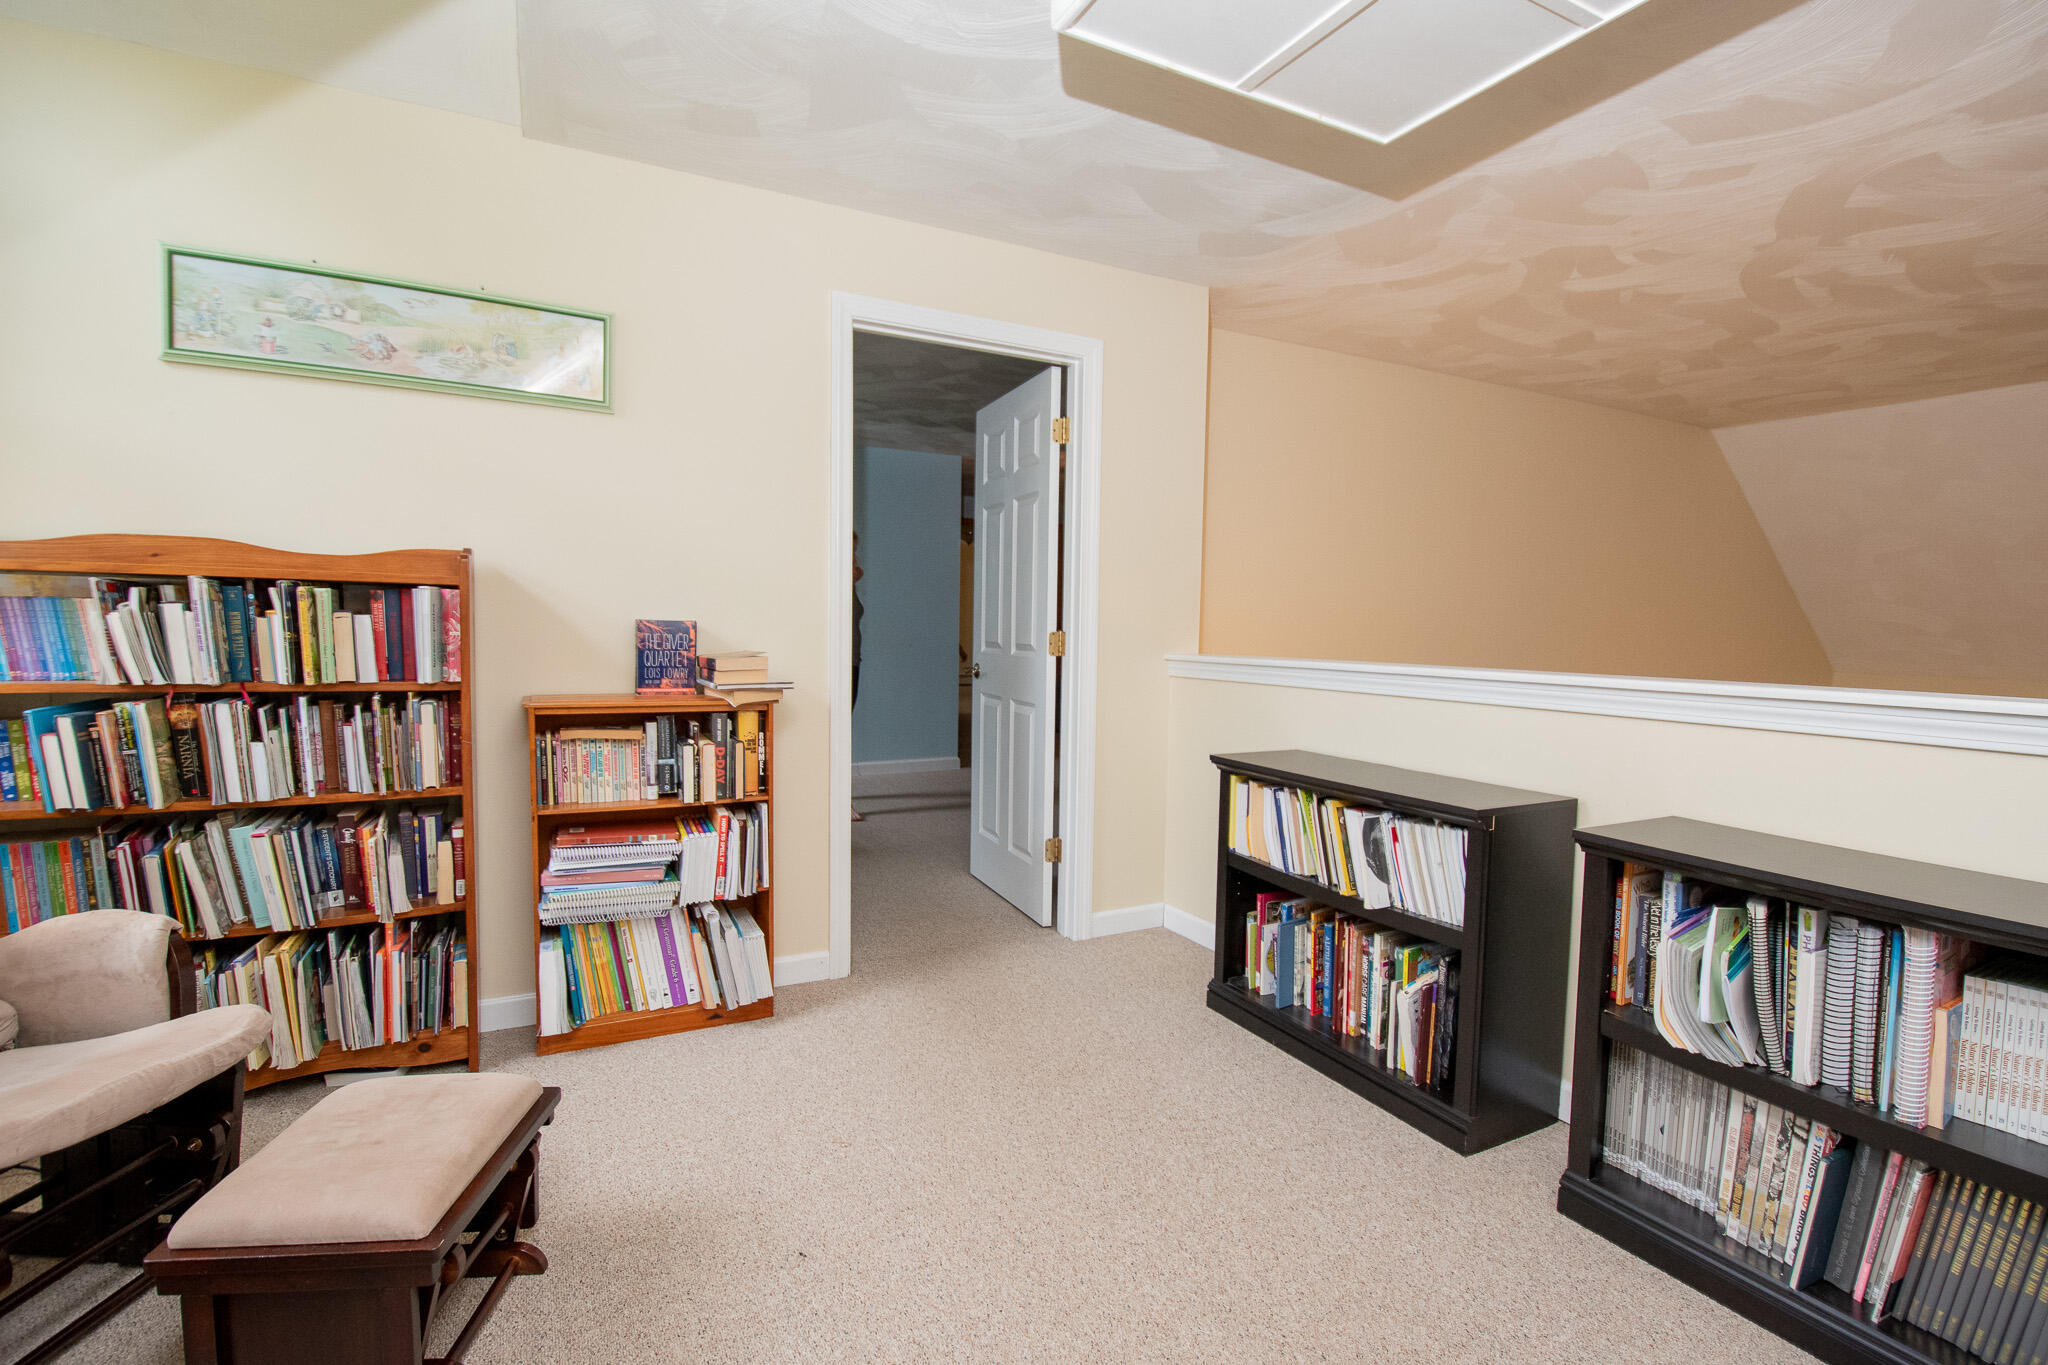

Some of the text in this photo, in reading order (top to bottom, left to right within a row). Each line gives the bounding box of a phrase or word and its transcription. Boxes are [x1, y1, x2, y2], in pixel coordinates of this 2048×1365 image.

[644, 633, 689, 650] THE GIVER
[644, 650, 688, 667] QUARTET
[644, 668, 688, 678] LOIS LOWRY
[178, 735, 194, 779] NARNIA
[715, 746, 725, 784] D-DAY
[720, 833, 725, 841] TO
[326, 861, 337, 890] DICTIONARY
[1614, 930, 1620, 939] OF
[1647, 904, 1661, 958] Vet in the Vestry
[669, 959, 679, 978] Grade
[1957, 1038, 1969, 1090] Nature's Children
[1966, 1041, 1978, 1094] Nature's Children
[1977, 1043, 1990, 1096] Nature's Children
[1988, 1047, 2001, 1100] Nature's Children
[1999, 1050, 2012, 1104] Nature's Children
[2010, 1053, 2023, 1107] Nature's Children
[2021, 1055, 2034, 1110] Nature's Children
[2031, 1057, 2044, 1112] Nature's Children
[1815, 1124, 1825, 1142] 365
[1807, 1143, 1822, 1179] THINGS
[1833, 1268, 1841, 1279] The
